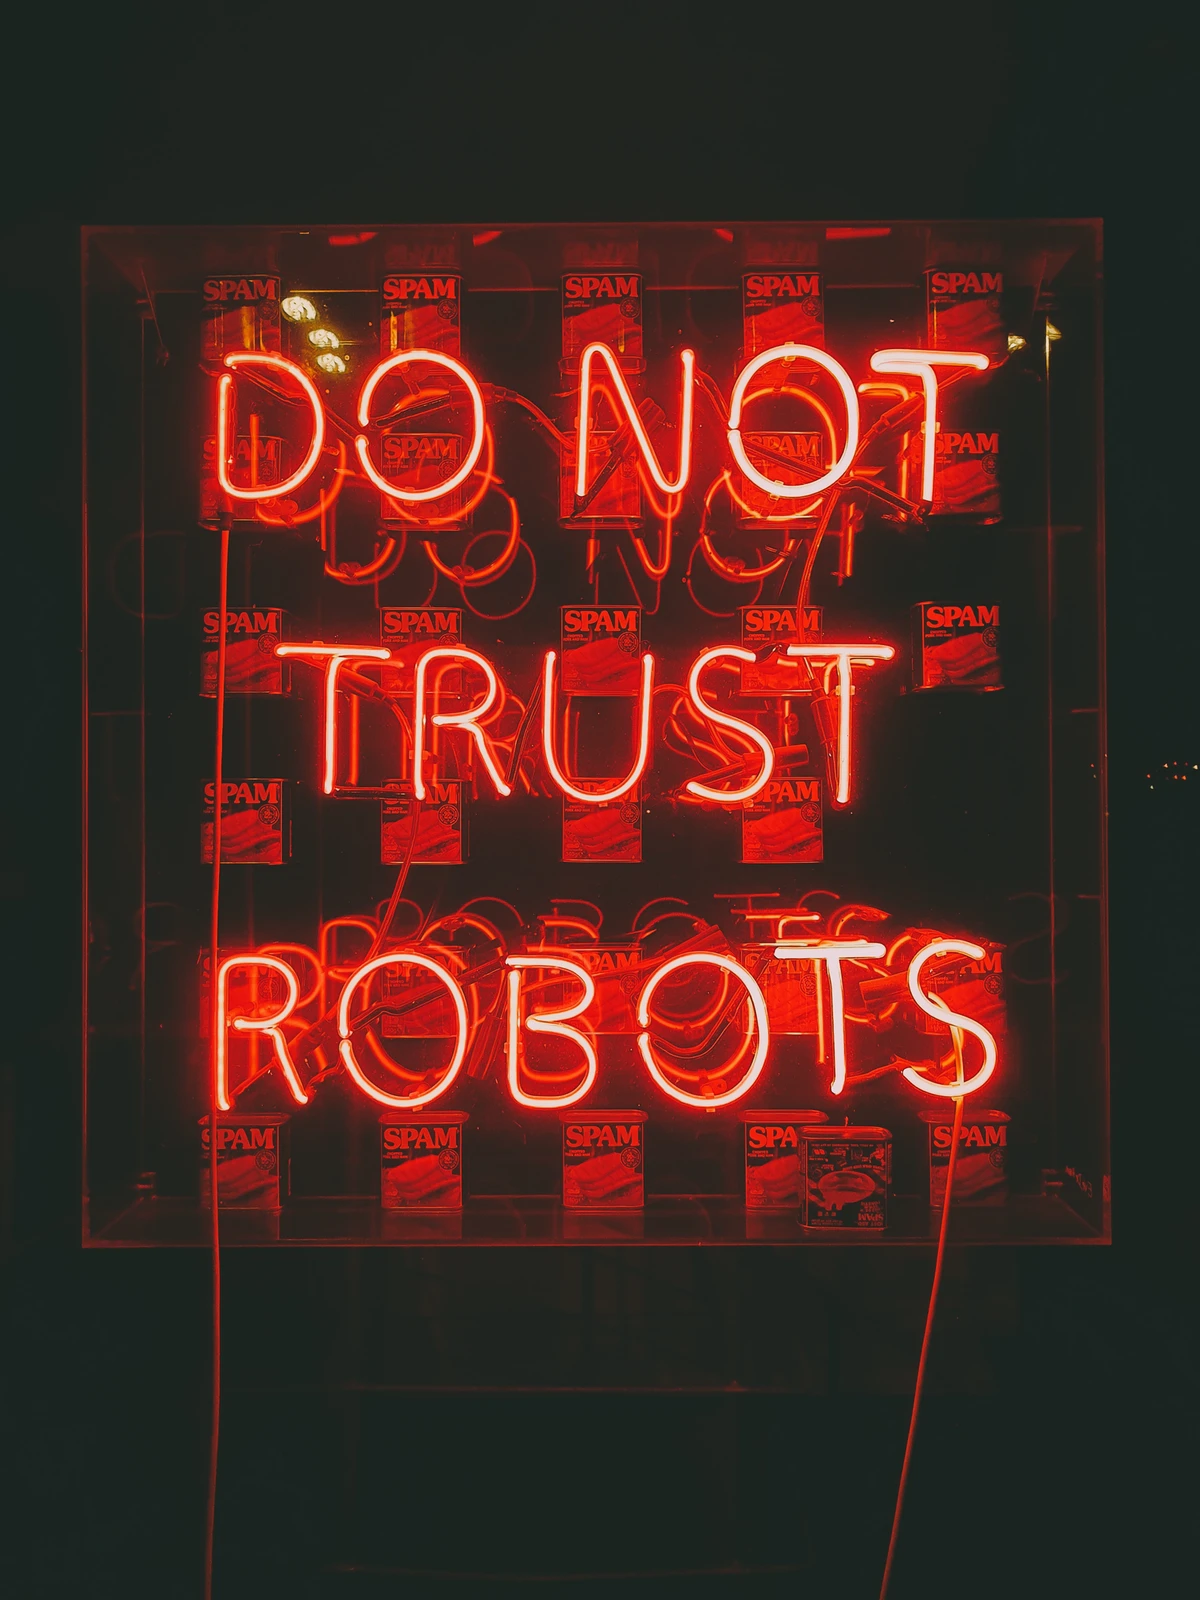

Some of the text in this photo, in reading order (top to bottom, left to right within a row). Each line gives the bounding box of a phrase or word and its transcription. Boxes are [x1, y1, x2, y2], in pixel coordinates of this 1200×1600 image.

[202, 278, 276, 302] SPAM
[383, 277, 457, 300] SPAM
[564, 276, 639, 299] SPAM
[746, 274, 821, 297] SPAM
[931, 271, 1004, 294] SPAM
[216, 342, 990, 503] DO NOT
[203, 438, 276, 461] SAM
[383, 436, 459, 460] SPAM
[203, 611, 278, 634] SPAM
[384, 609, 459, 633] SPAM
[564, 609, 638, 632] SPAM
[745, 609, 820, 632] SPAM
[926, 604, 999, 628] SPAM
[275, 644, 895, 805] TRUST
[203, 782, 280, 805] SPAM
[578, 951, 639, 974] PAM
[215, 938, 997, 1112] ROBOTS
[383, 1127, 458, 1150] SPAM
[565, 1125, 640, 1147] SPAM
[748, 1125, 799, 1149] SPA
[933, 1125, 1007, 1148] SPAM
